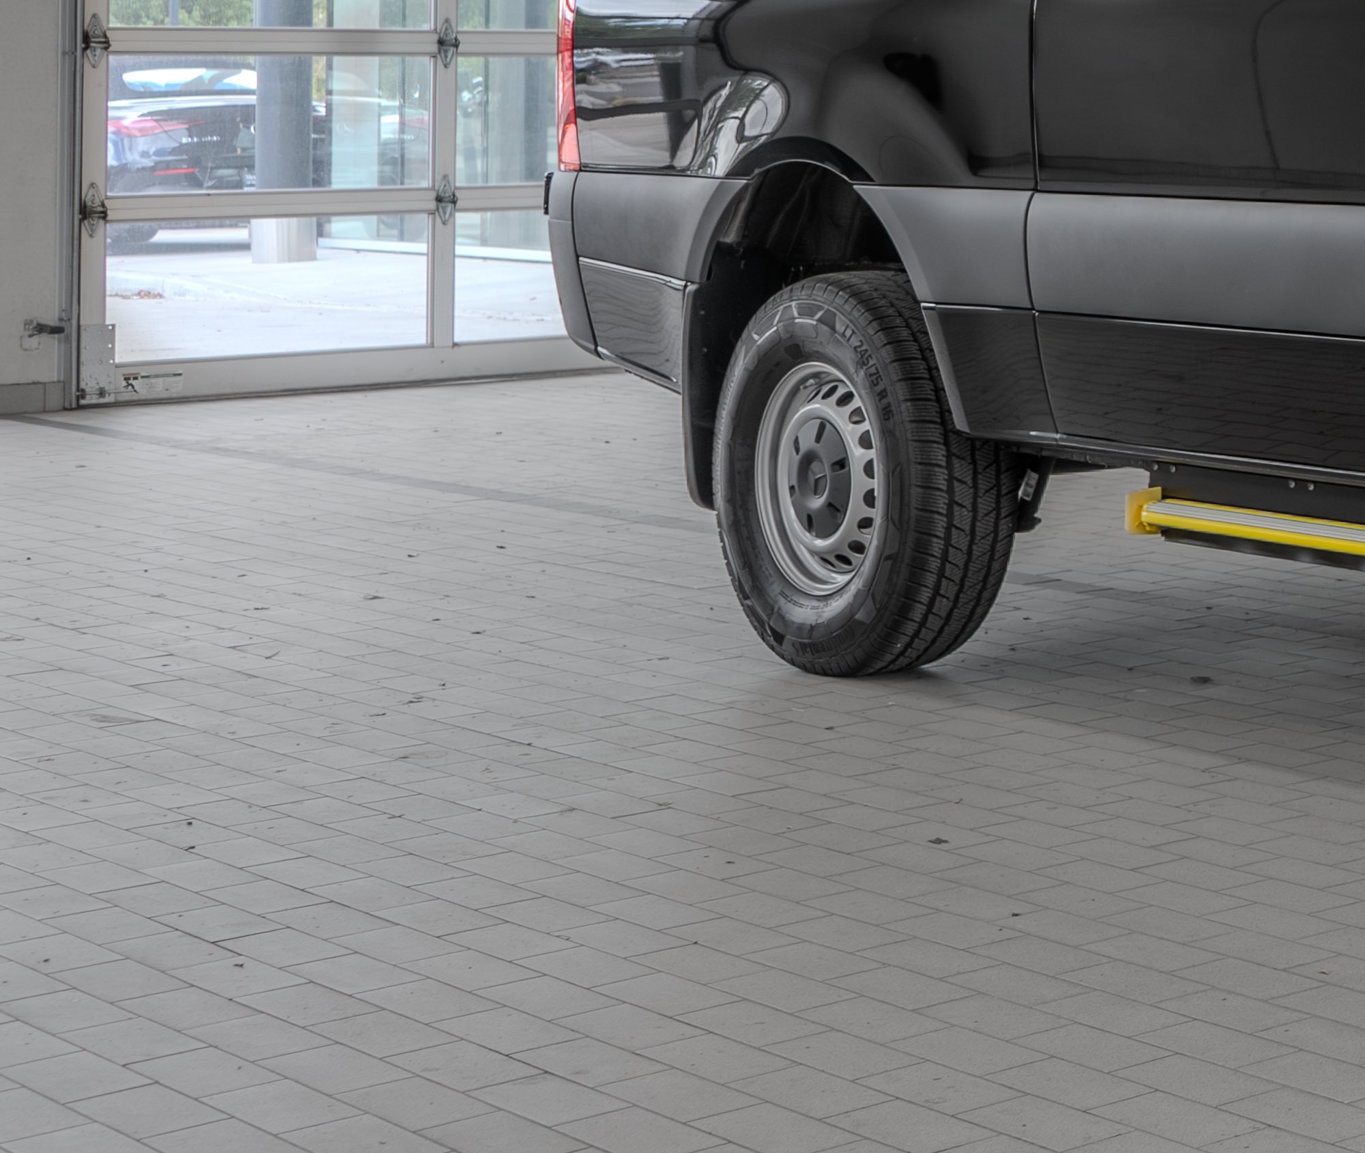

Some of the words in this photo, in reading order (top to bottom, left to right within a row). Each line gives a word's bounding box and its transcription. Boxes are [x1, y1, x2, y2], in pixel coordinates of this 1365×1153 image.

[842, 323, 856, 342] LT
[853, 339, 884, 388] 245/75
[877, 386, 888, 403] R
[881, 402, 894, 422] 16
